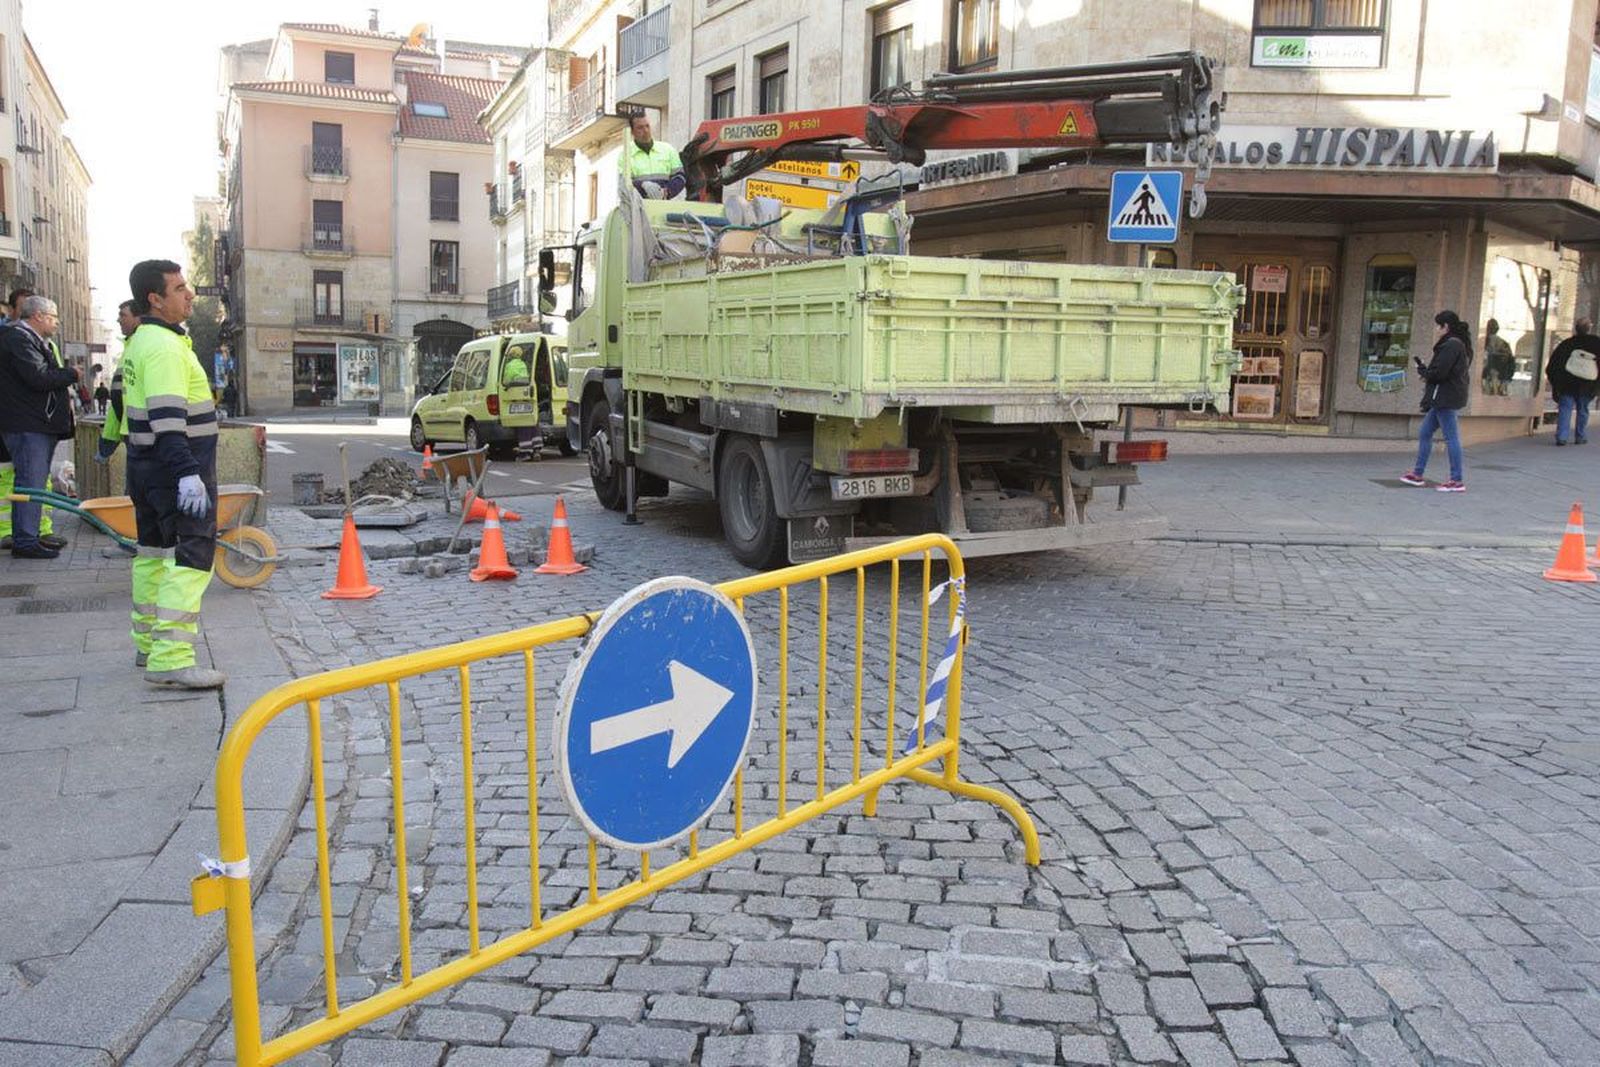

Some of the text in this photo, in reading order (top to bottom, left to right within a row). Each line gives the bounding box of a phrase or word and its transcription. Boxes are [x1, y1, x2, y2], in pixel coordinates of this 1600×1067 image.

[723, 122, 779, 140] PALFINGER
[788, 120, 800, 130] PK
[1287, 127, 1496, 168] HISPANIA
[770, 162, 823, 176] astellanos
[919, 151, 1009, 185] ARTESANIA
[748, 182, 774, 193] hotel
[841, 476, 911, 497] 2816 BKB
